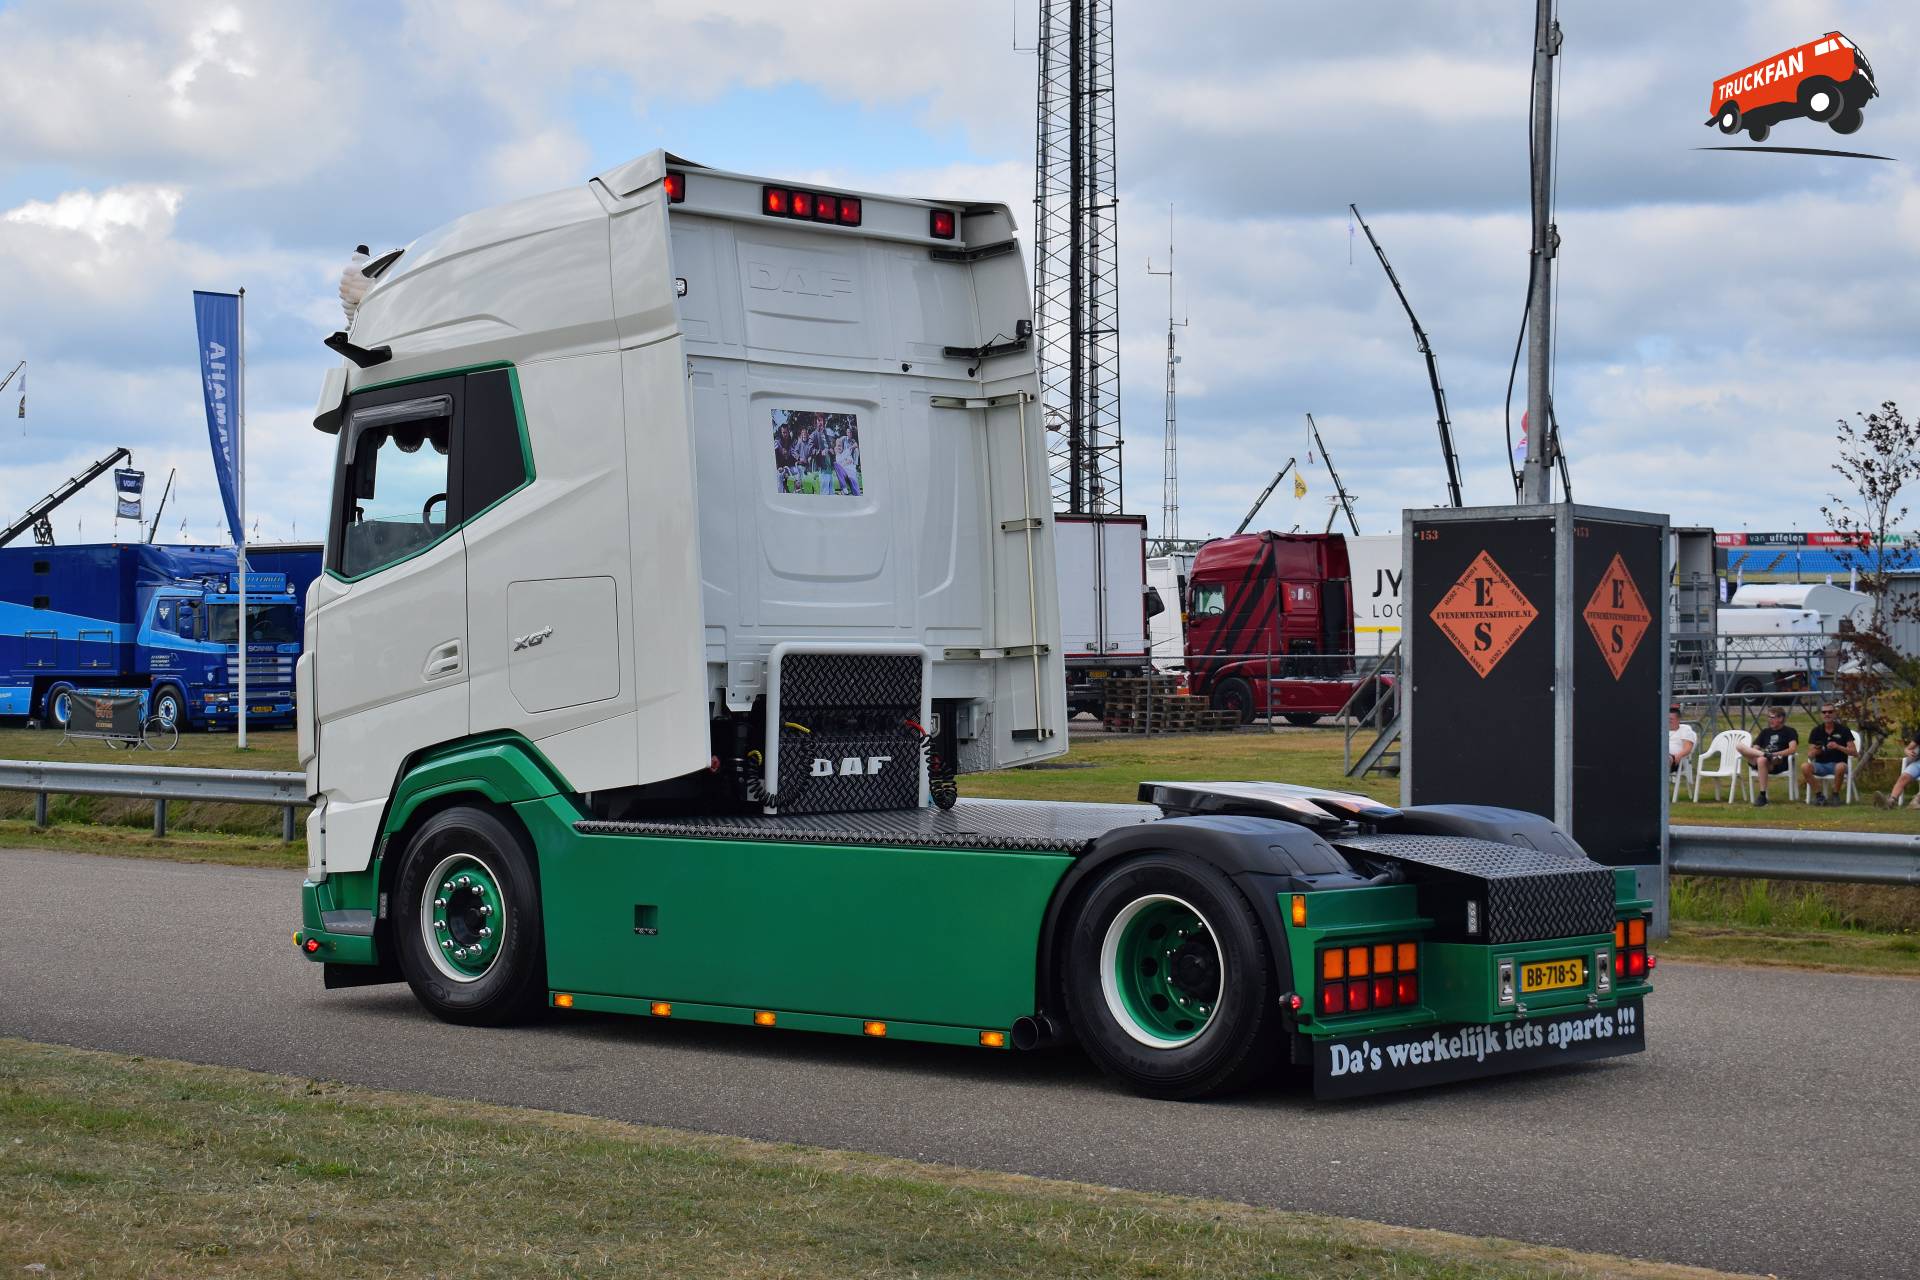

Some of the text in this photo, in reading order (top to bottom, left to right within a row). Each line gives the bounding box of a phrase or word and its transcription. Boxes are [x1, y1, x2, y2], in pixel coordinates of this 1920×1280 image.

[747, 261, 855, 298] DAF
[1420, 530, 1439, 541] 153
[1769, 534, 1804, 542] uffelen
[1372, 569, 1402, 597] JY
[1474, 577, 1493, 606] E
[1612, 579, 1625, 608] E
[1436, 610, 1533, 620] EVENEMENTENSERVICE.NL
[1474, 622, 1492, 651] S
[1611, 624, 1624, 653] S
[810, 756, 892, 777] DAF
[1527, 964, 1577, 987] BB-718-S
[1330, 1006, 1635, 1076] Da's werkelijk iets aparts !!!
